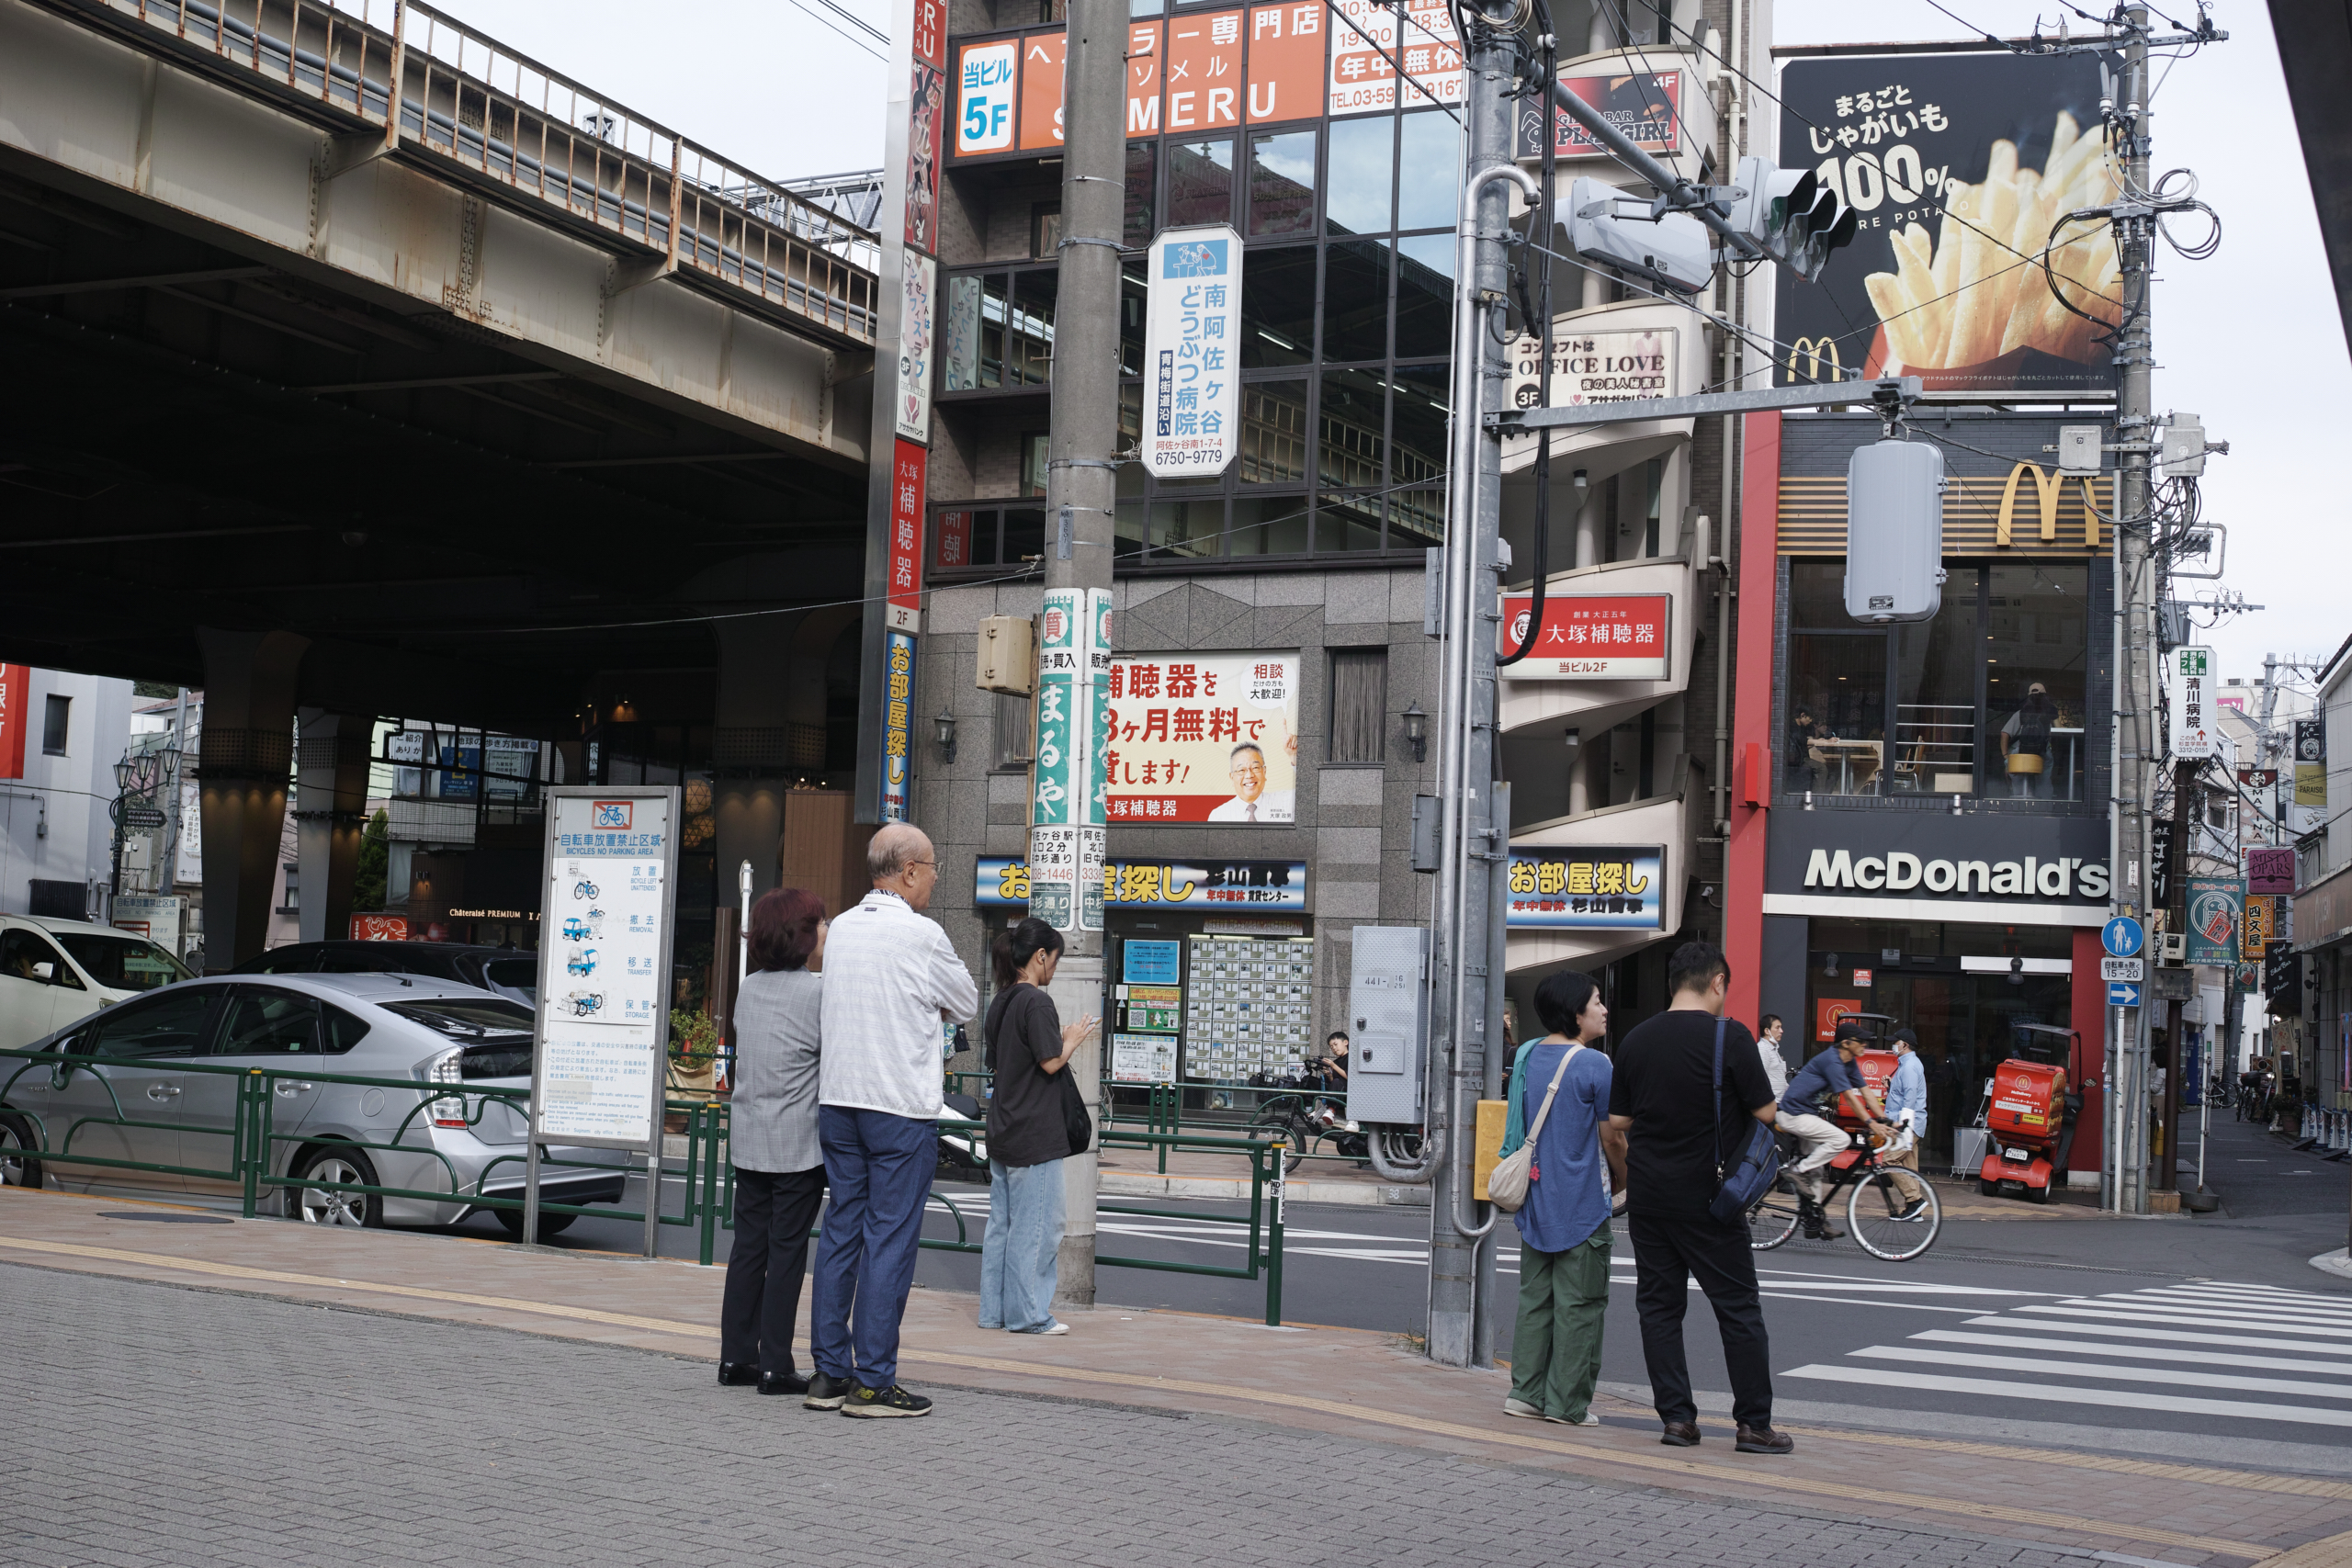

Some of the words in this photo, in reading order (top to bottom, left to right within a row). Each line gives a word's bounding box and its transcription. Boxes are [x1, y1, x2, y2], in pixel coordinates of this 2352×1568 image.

[1136, 55, 1228, 86] ソメル
[1341, 45, 1460, 80] 年中無休
[964, 58, 1012, 89] 当ビル
[1654, 75, 1676, 88] 4F
[1836, 85, 1913, 118] まるごと
[964, 96, 1009, 140] 5F
[1604, 110, 1634, 123] BAR
[1809, 103, 1950, 154] じゃがいも
[1815, 143, 1958, 211] 100%
[1521, 341, 1595, 355] コンセプトは
[900, 359, 910, 373] 3F
[1175, 285, 1202, 436] どうぶつ病院
[1606, 355, 1666, 373] LOVE
[1581, 377, 1666, 391] 夜の美人秘書室
[1159, 353, 1173, 435] 青梅街道沿い
[1518, 391, 1539, 405] 3F
[1156, 450, 1223, 466] 6750-9779
[899, 460, 918, 480] 大塚
[896, 481, 916, 589] 補聴器
[897, 610, 909, 626] 2F
[1046, 611, 1062, 640] 質
[1546, 623, 1655, 645] 大塚補聴器
[1253, 663, 1283, 680] 相談
[1559, 662, 1608, 673] 当ビル2F
[1250, 688, 1285, 700] 大歓迎!
[2186, 677, 2201, 729] 清川病院
[887, 644, 910, 785] お部屋探し
[1035, 681, 1065, 818] まるや
[2299, 785, 2324, 794] PARAISO
[560, 833, 662, 847] 自転車放置禁止区域
[566, 847, 595, 855] BICYCLES
[2253, 853, 2290, 863] MISTY
[632, 865, 657, 877] 放置
[1206, 866, 1290, 888] 杉山商事
[1804, 848, 2110, 898] McDonald's
[2252, 863, 2291, 875] OPARS
[1510, 860, 1648, 896] お部屋探し
[117, 897, 176, 908] 自転車放置禁止区域
[1206, 889, 1246, 902] 年中無休
[1247, 889, 1290, 903] 賃貸センター
[449, 908, 485, 918] Châteraisé
[487, 909, 521, 919] PREMIUM
[1512, 900, 1566, 912] 年中無休
[1571, 897, 1644, 914] 杉山商事
[629, 914, 654, 925] 撤去
[2247, 904, 2262, 947] 四文屋
[628, 956, 652, 968] 移送
[2105, 961, 2140, 969] 自転車を除く
[626, 999, 650, 1010] 保管
